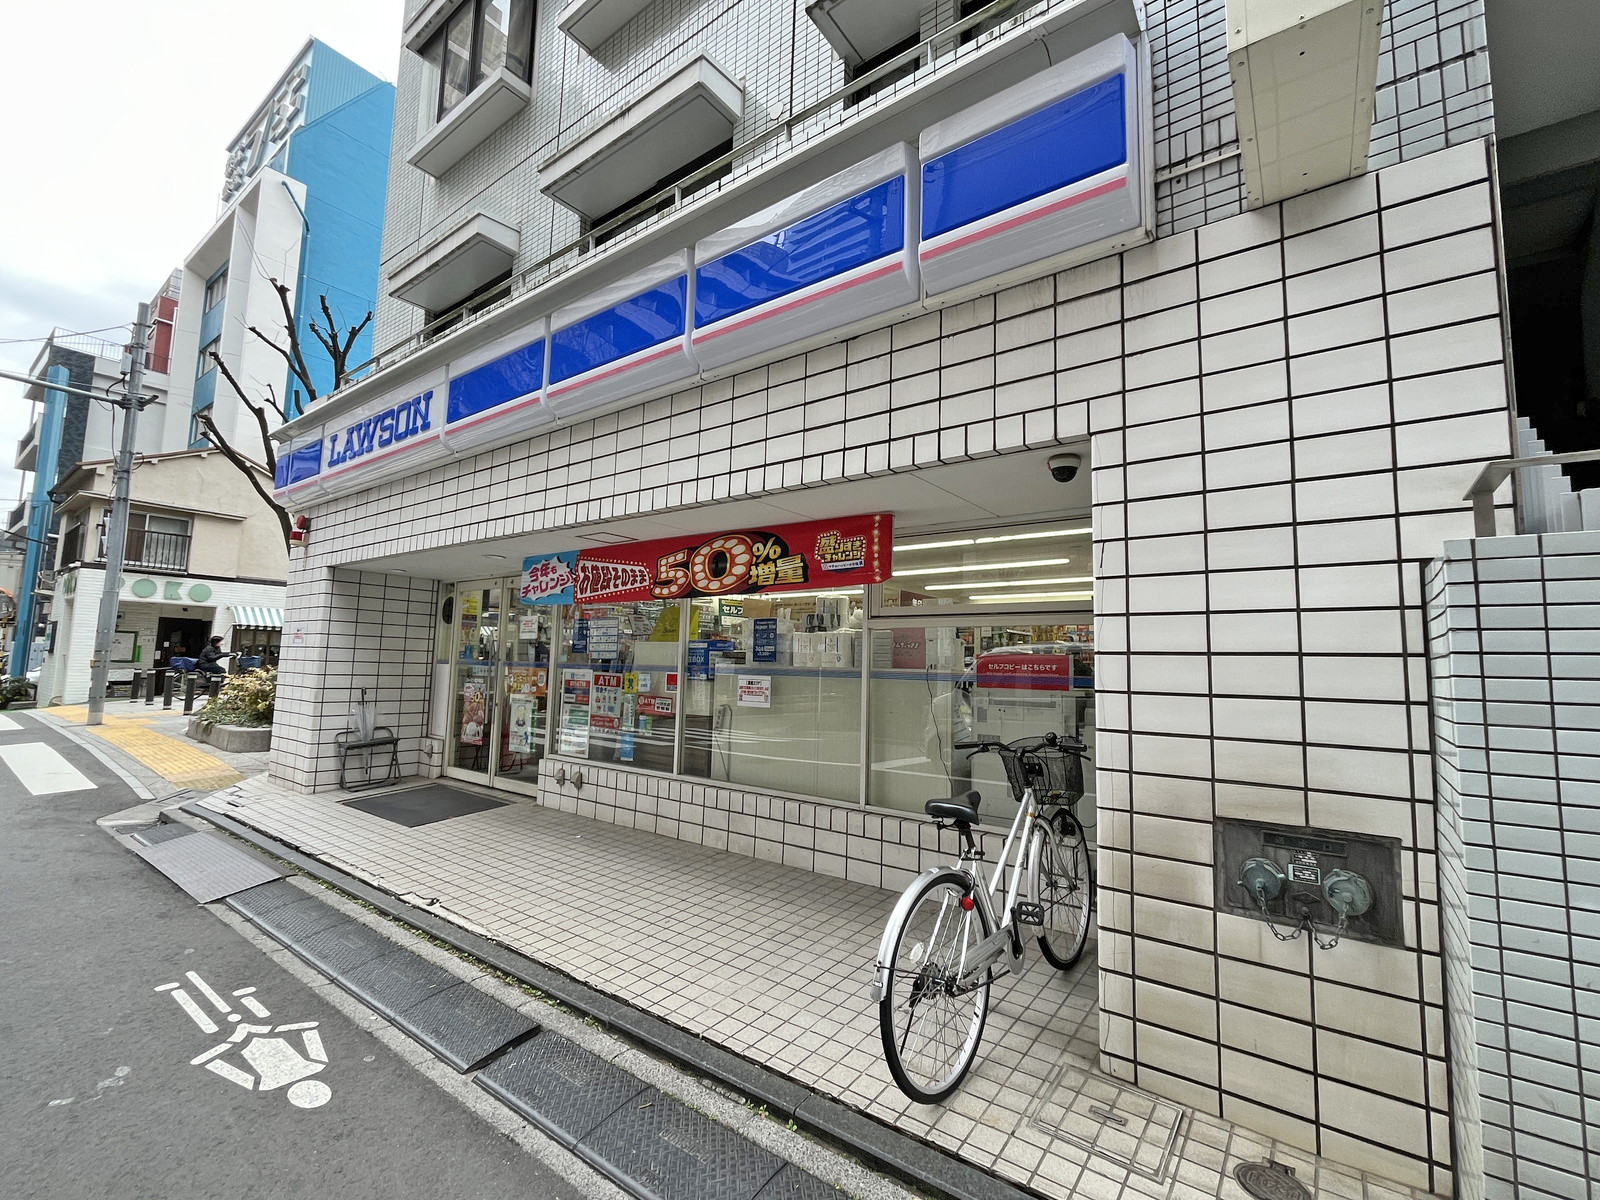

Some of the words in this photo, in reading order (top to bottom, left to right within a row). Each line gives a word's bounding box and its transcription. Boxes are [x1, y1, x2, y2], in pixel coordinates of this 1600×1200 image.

[328, 390, 434, 468] LAWSON
[528, 562, 558, 583] 今年も
[578, 562, 648, 596] お値段そのまま
[748, 554, 805, 586] 増量
[119, 577, 213, 603] OKO
[987, 663, 1058, 671] セルフコピーはこちらです
[597, 675, 617, 687] ATM
